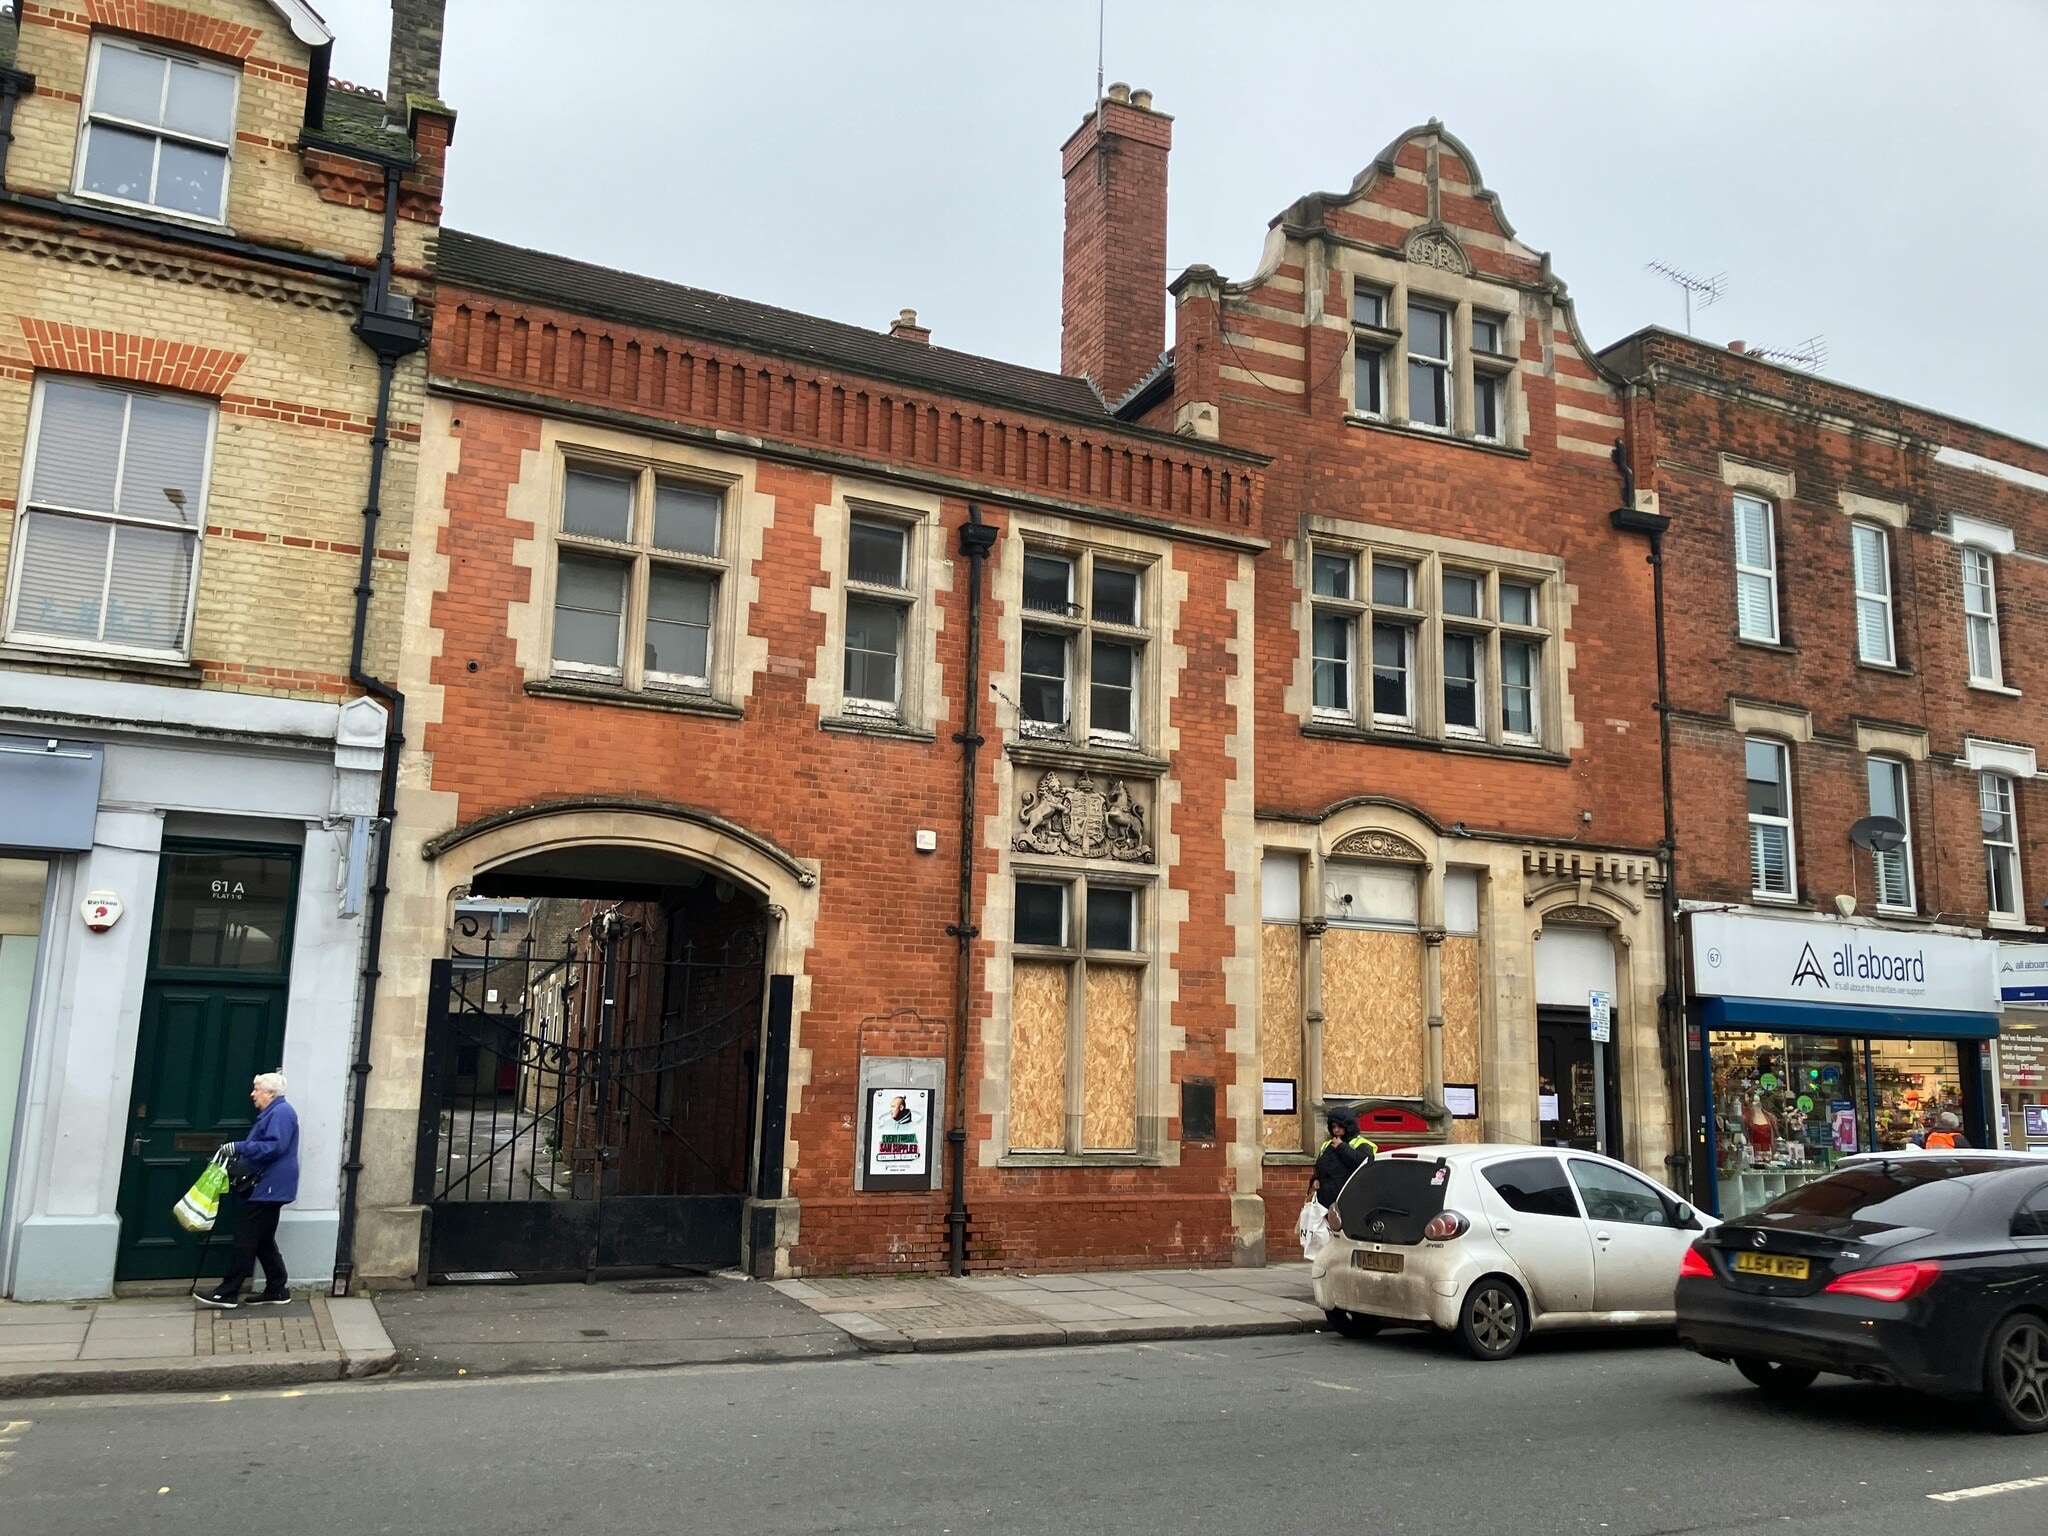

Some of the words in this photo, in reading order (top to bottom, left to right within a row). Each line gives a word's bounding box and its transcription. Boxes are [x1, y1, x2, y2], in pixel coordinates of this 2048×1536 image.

[211, 880, 228, 893] 61
[232, 881, 245, 894] A
[1710, 953, 1719, 962] 67
[1833, 943, 1854, 977] all
[1857, 945, 1925, 983] aboard
[1850, 983, 1865, 992] about
[1866, 984, 1875, 993] the
[2016, 1034, 2031, 1042] found
[2011, 1073, 2025, 1081] good
[892, 1143, 918, 1154] SUPPLIER
